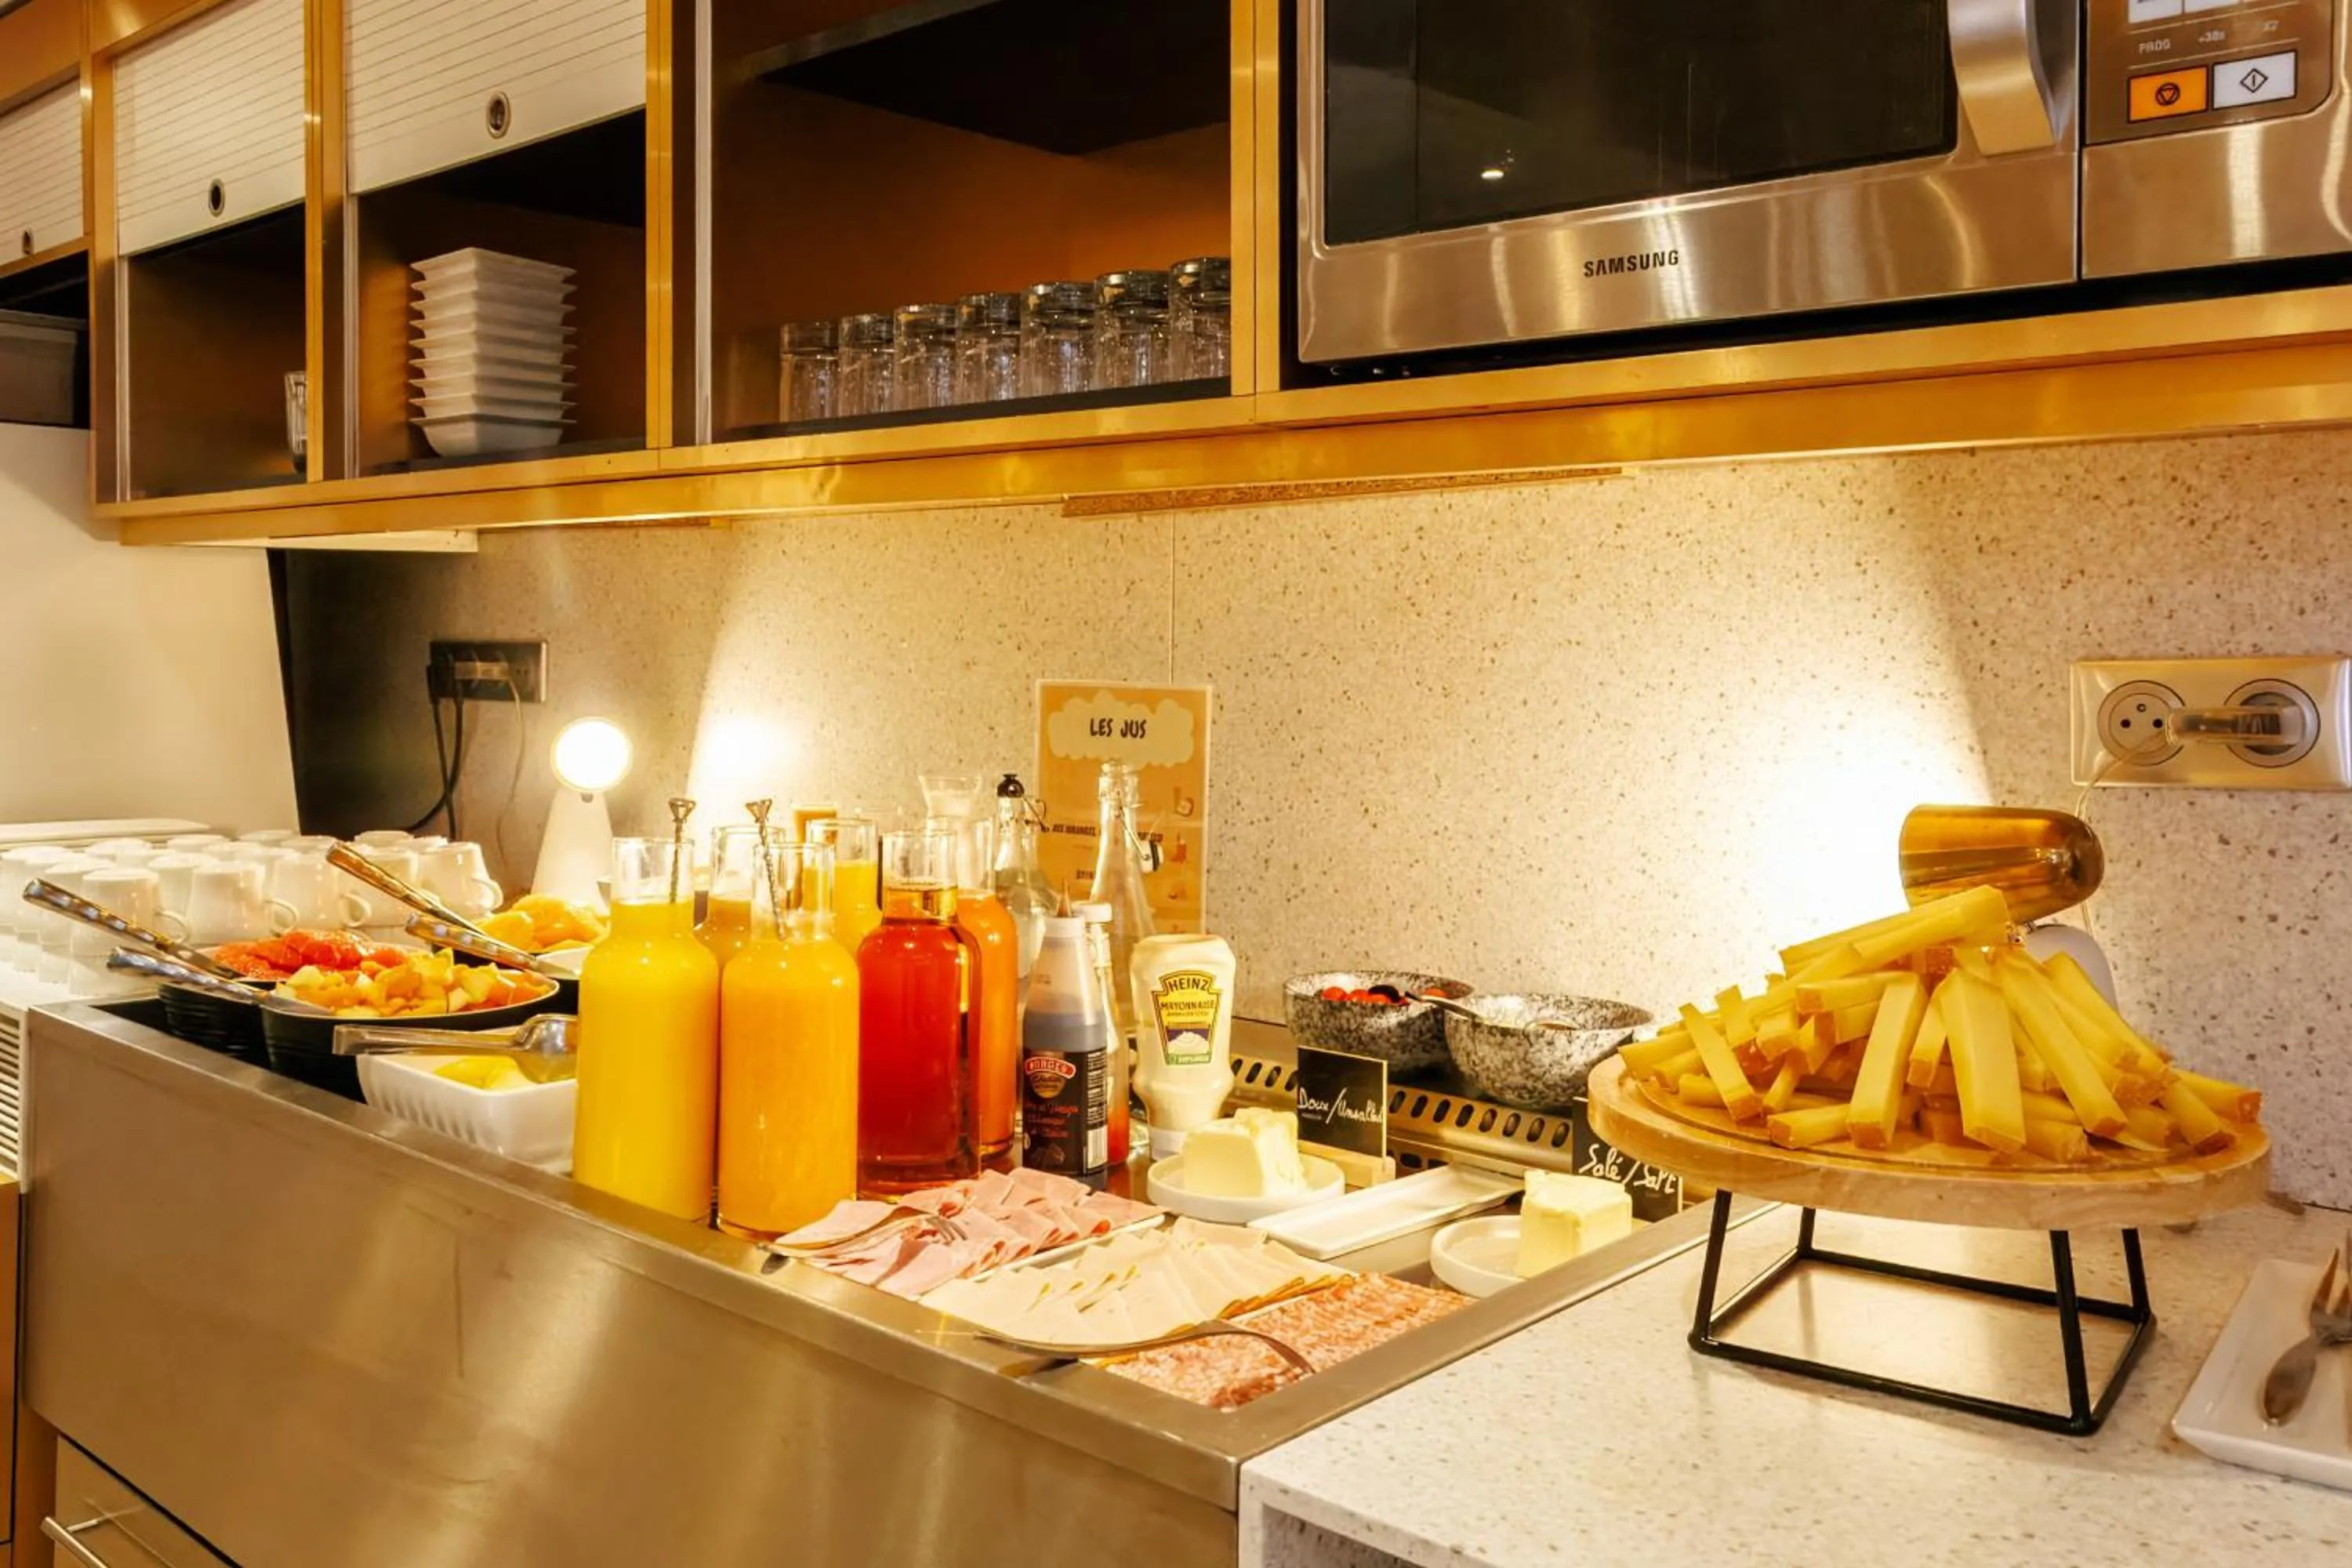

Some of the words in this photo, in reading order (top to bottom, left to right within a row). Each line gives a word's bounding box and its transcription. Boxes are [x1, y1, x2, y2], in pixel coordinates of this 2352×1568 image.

[1583, 249, 1679, 278] SAMSUNG
[1090, 717, 1113, 738] LES
[1120, 718, 1146, 739] JUS
[1167, 977, 1209, 992] HEINZ
